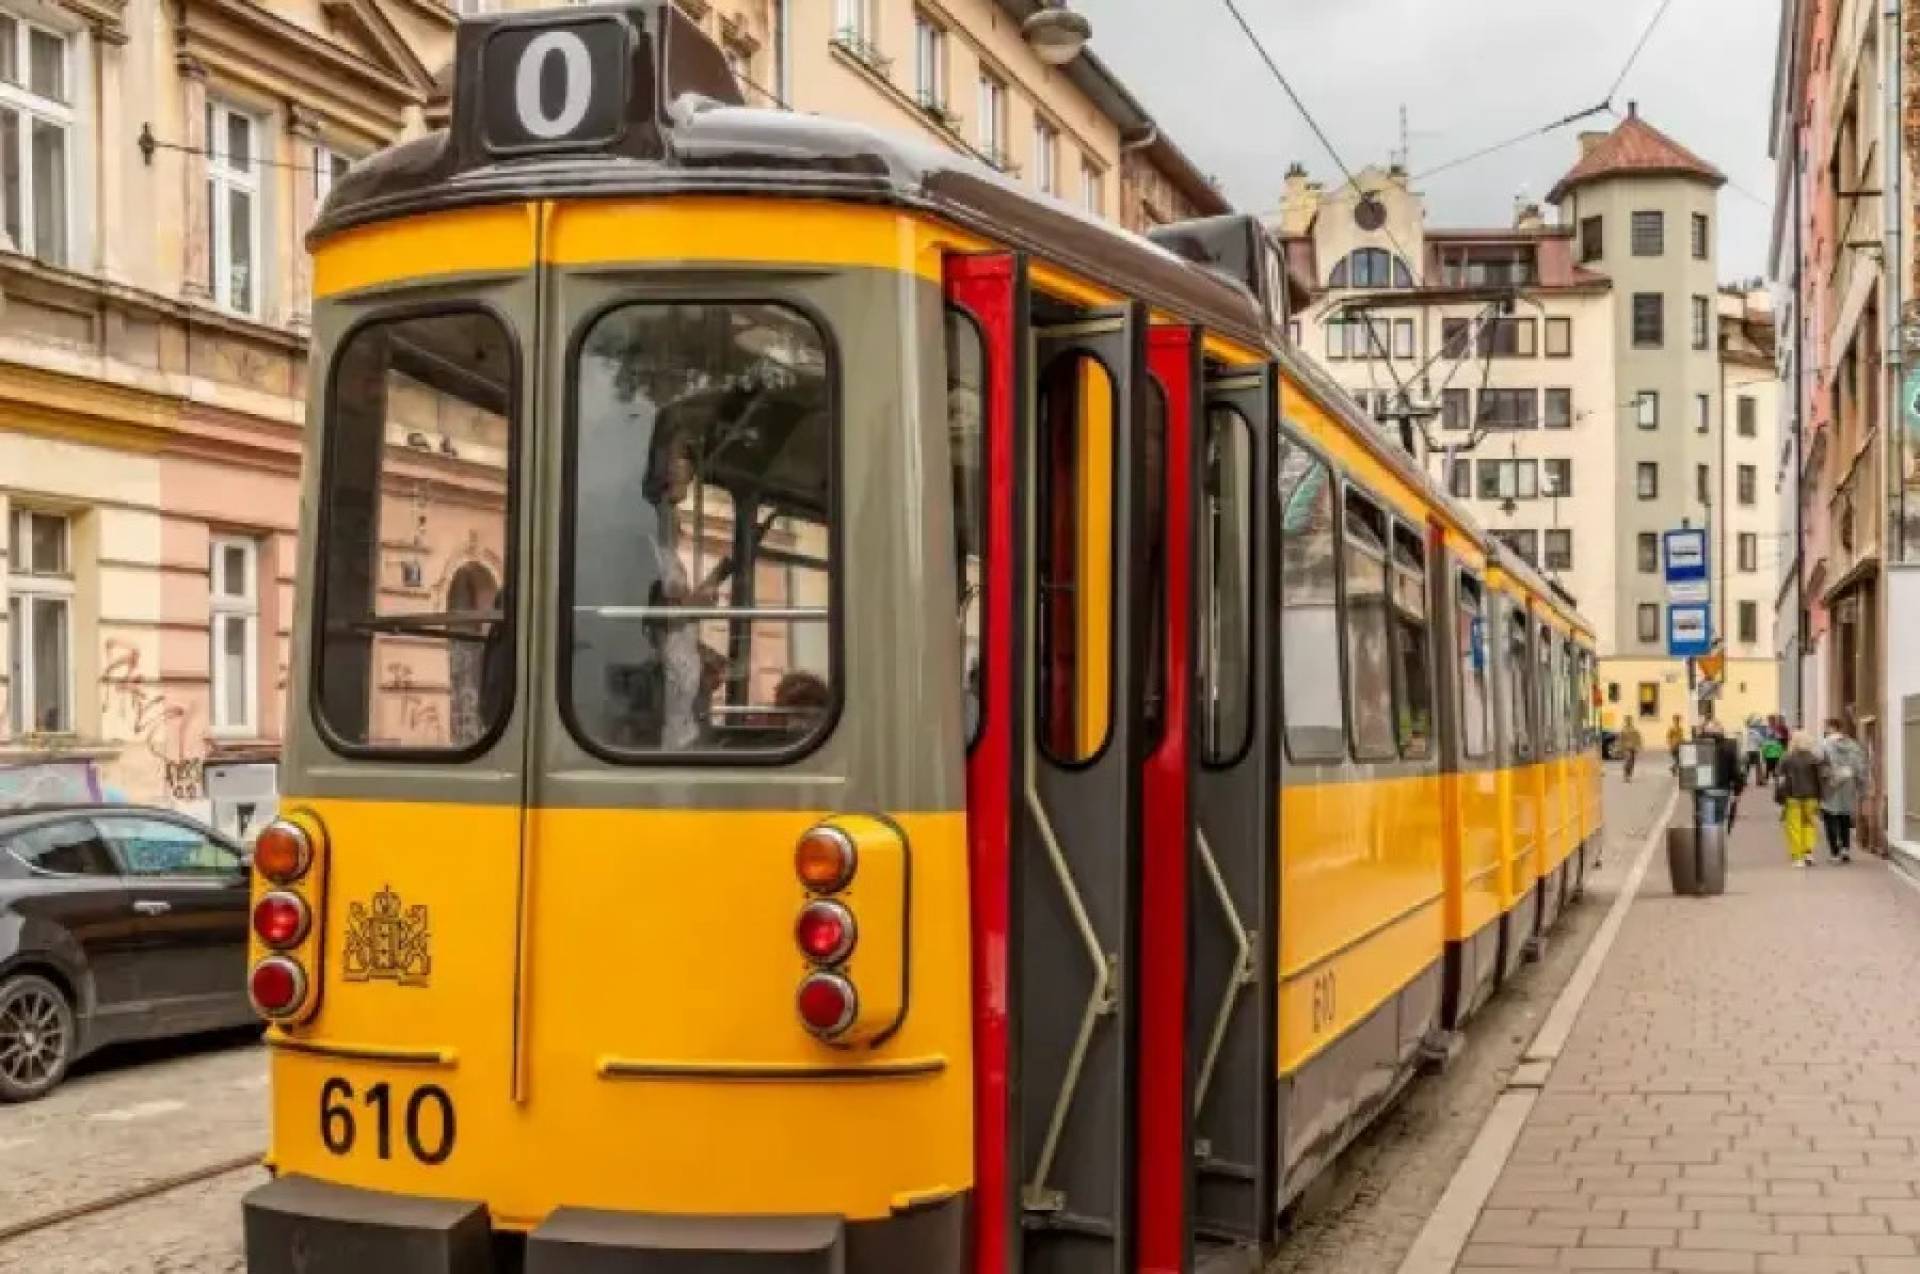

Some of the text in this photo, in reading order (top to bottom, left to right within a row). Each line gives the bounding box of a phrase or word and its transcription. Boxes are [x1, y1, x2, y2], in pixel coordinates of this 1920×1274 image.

[515, 31, 592, 139] 0
[1312, 968, 1337, 1034] 610
[320, 1077, 457, 1165] 610
